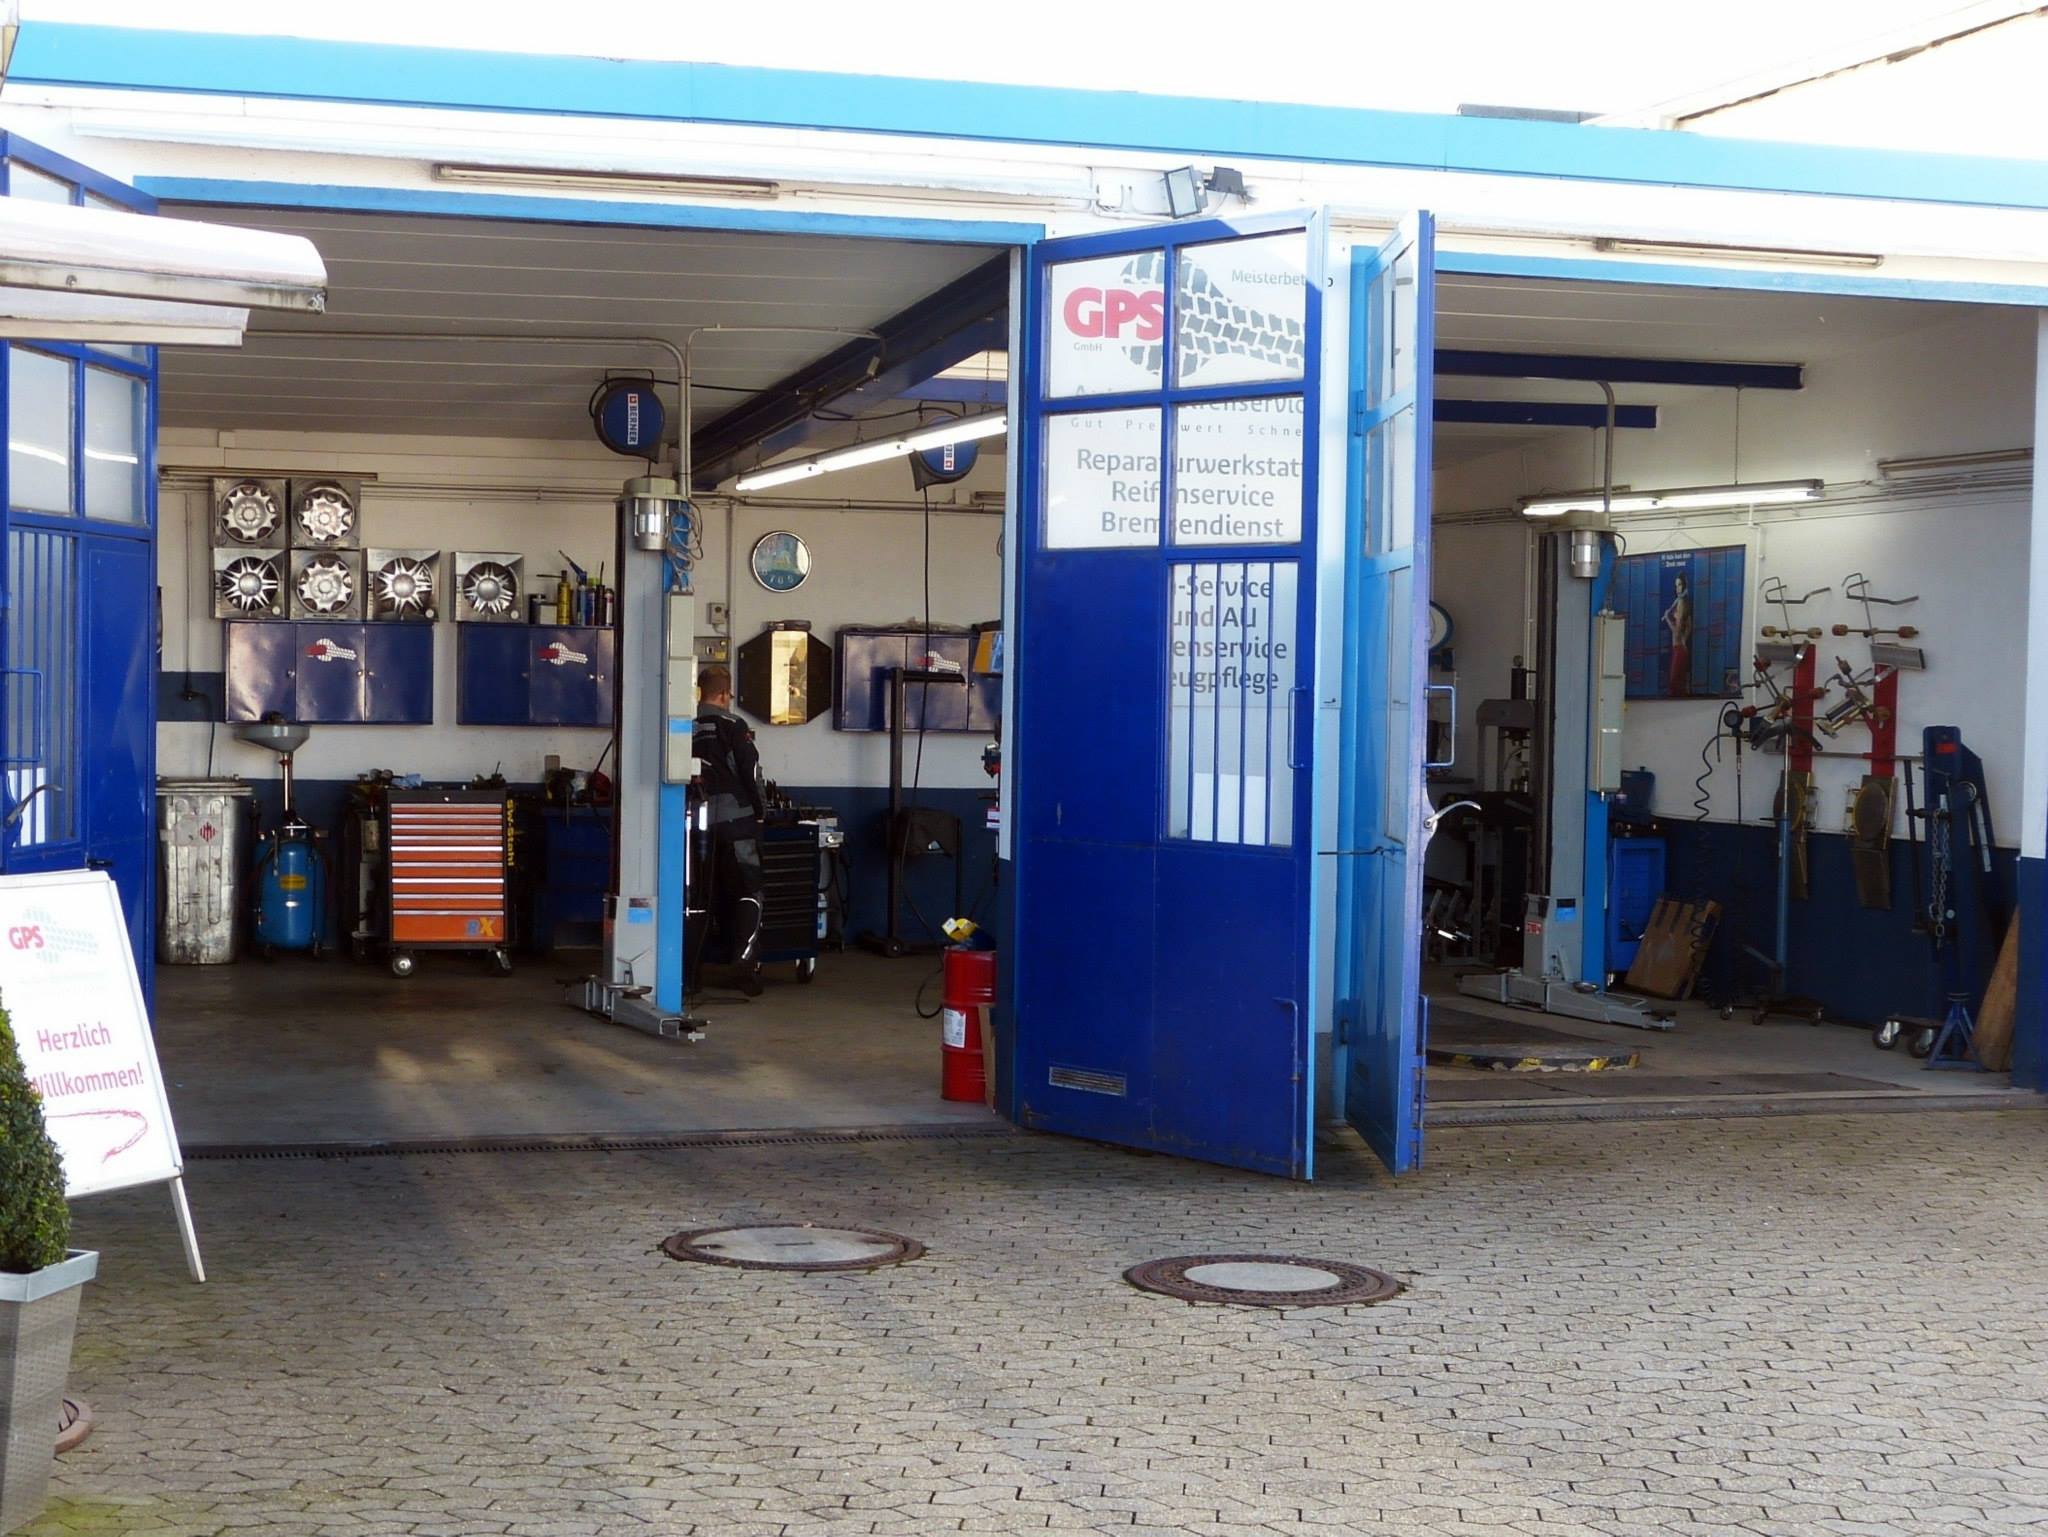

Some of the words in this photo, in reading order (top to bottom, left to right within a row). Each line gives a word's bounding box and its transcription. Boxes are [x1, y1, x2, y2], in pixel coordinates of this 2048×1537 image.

[1064, 287, 1164, 341] GPS
[1073, 341, 1103, 353] GmbH
[1070, 417, 1103, 429] Gut
[1077, 448, 1302, 478] Reparaurwerkstat
[1111, 480, 1275, 507] Reifnservice
[1101, 511, 1284, 538] Bremendienst
[8, 925, 45, 950] GPS
[36, 1021, 112, 1053] Herzlich
